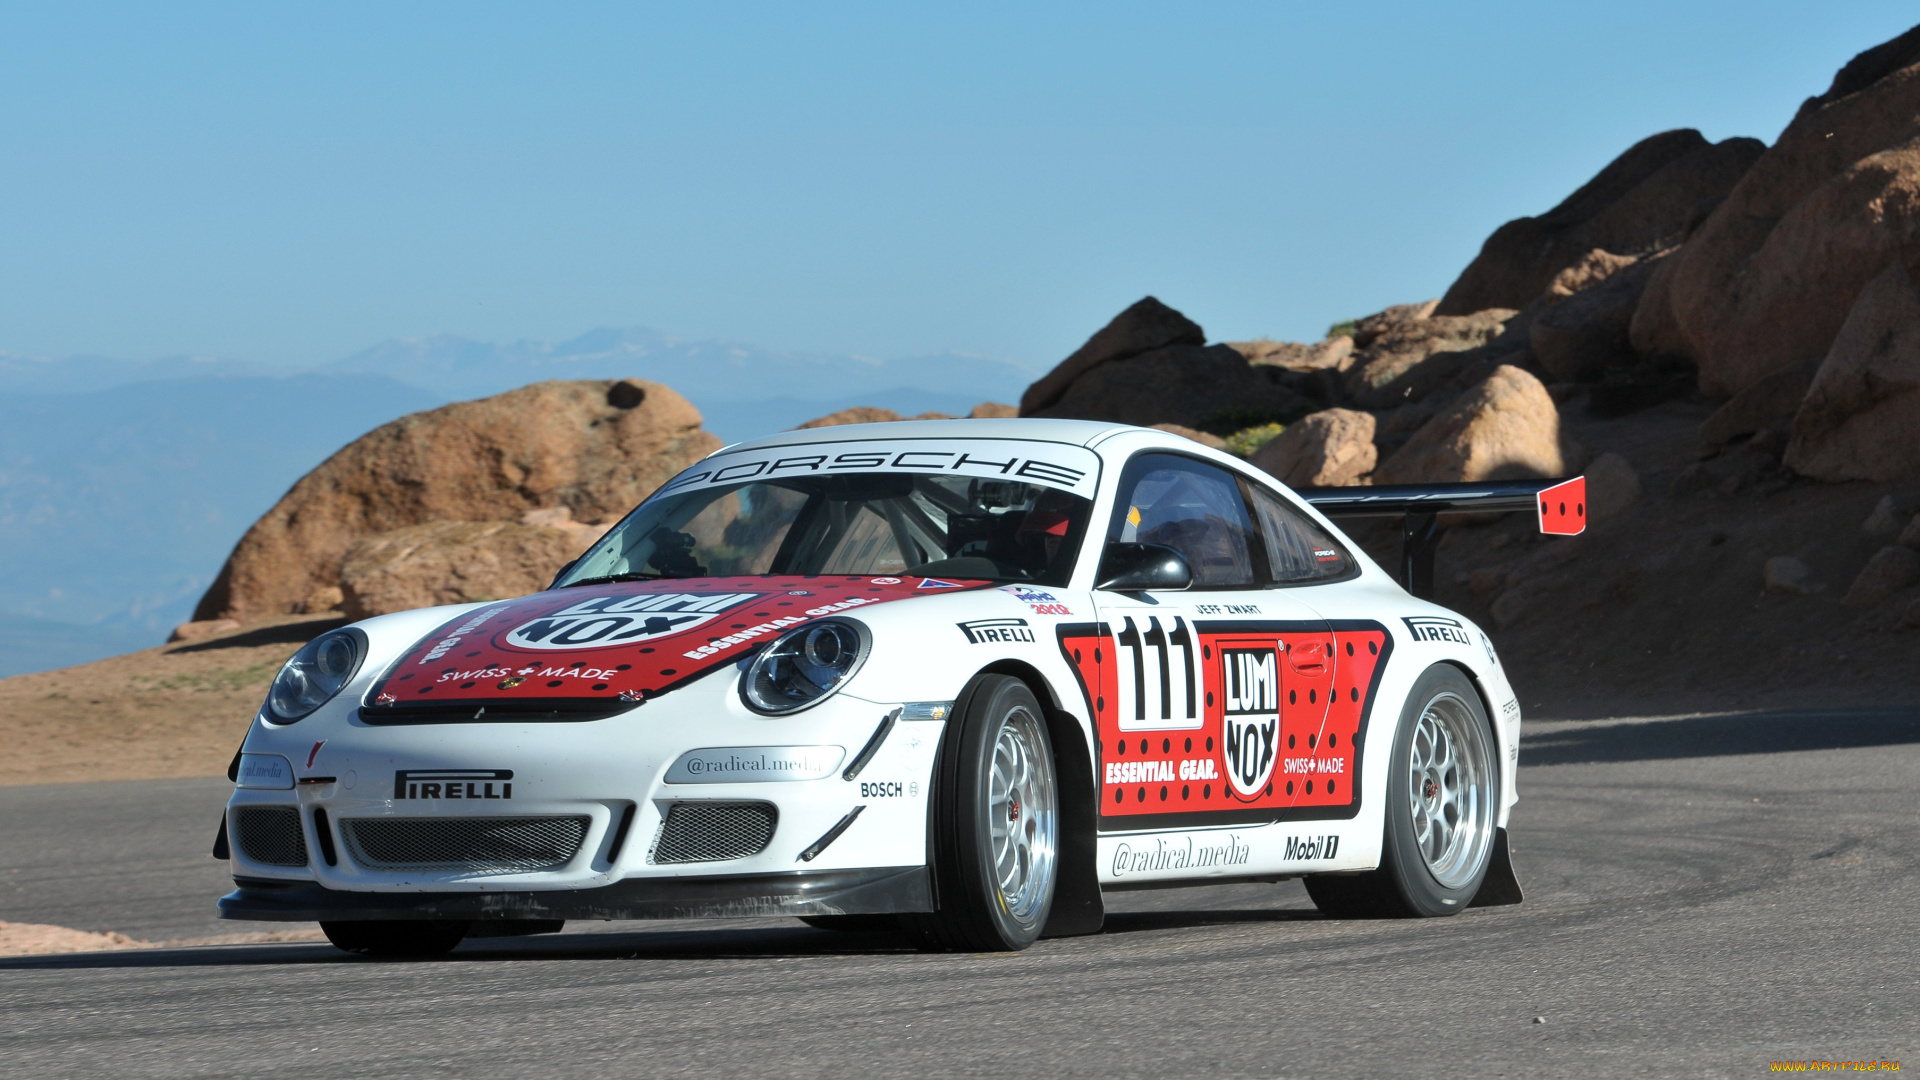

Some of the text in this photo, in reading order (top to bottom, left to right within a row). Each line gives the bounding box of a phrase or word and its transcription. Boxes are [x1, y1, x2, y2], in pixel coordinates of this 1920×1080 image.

[653, 452, 1086, 499] PORSCHE
[552, 593, 758, 615] LUMI
[1030, 604, 1072, 615] 2010
[1196, 604, 1262, 615] JEFF ZWART
[516, 616, 703, 645] NOX
[683, 596, 880, 660] ESSENTIAL GEAR.
[956, 618, 1036, 643] PIRELLI
[1400, 616, 1471, 646] PIRELLI
[437, 667, 618, 683] SWISS MADE
[1117, 615, 1197, 721] 111
[1224, 652, 1277, 712] LUMI
[1227, 718, 1276, 787] NOX
[1284, 757, 1345, 774] SWISS MADE
[394, 769, 514, 800] PIRELLI
[1106, 758, 1219, 784] ESSENTIAL GEAR.
[860, 782, 903, 798] BOSCH
[1112, 834, 1250, 876] @radical.media
[1283, 836, 1340, 861] Mobil 1
